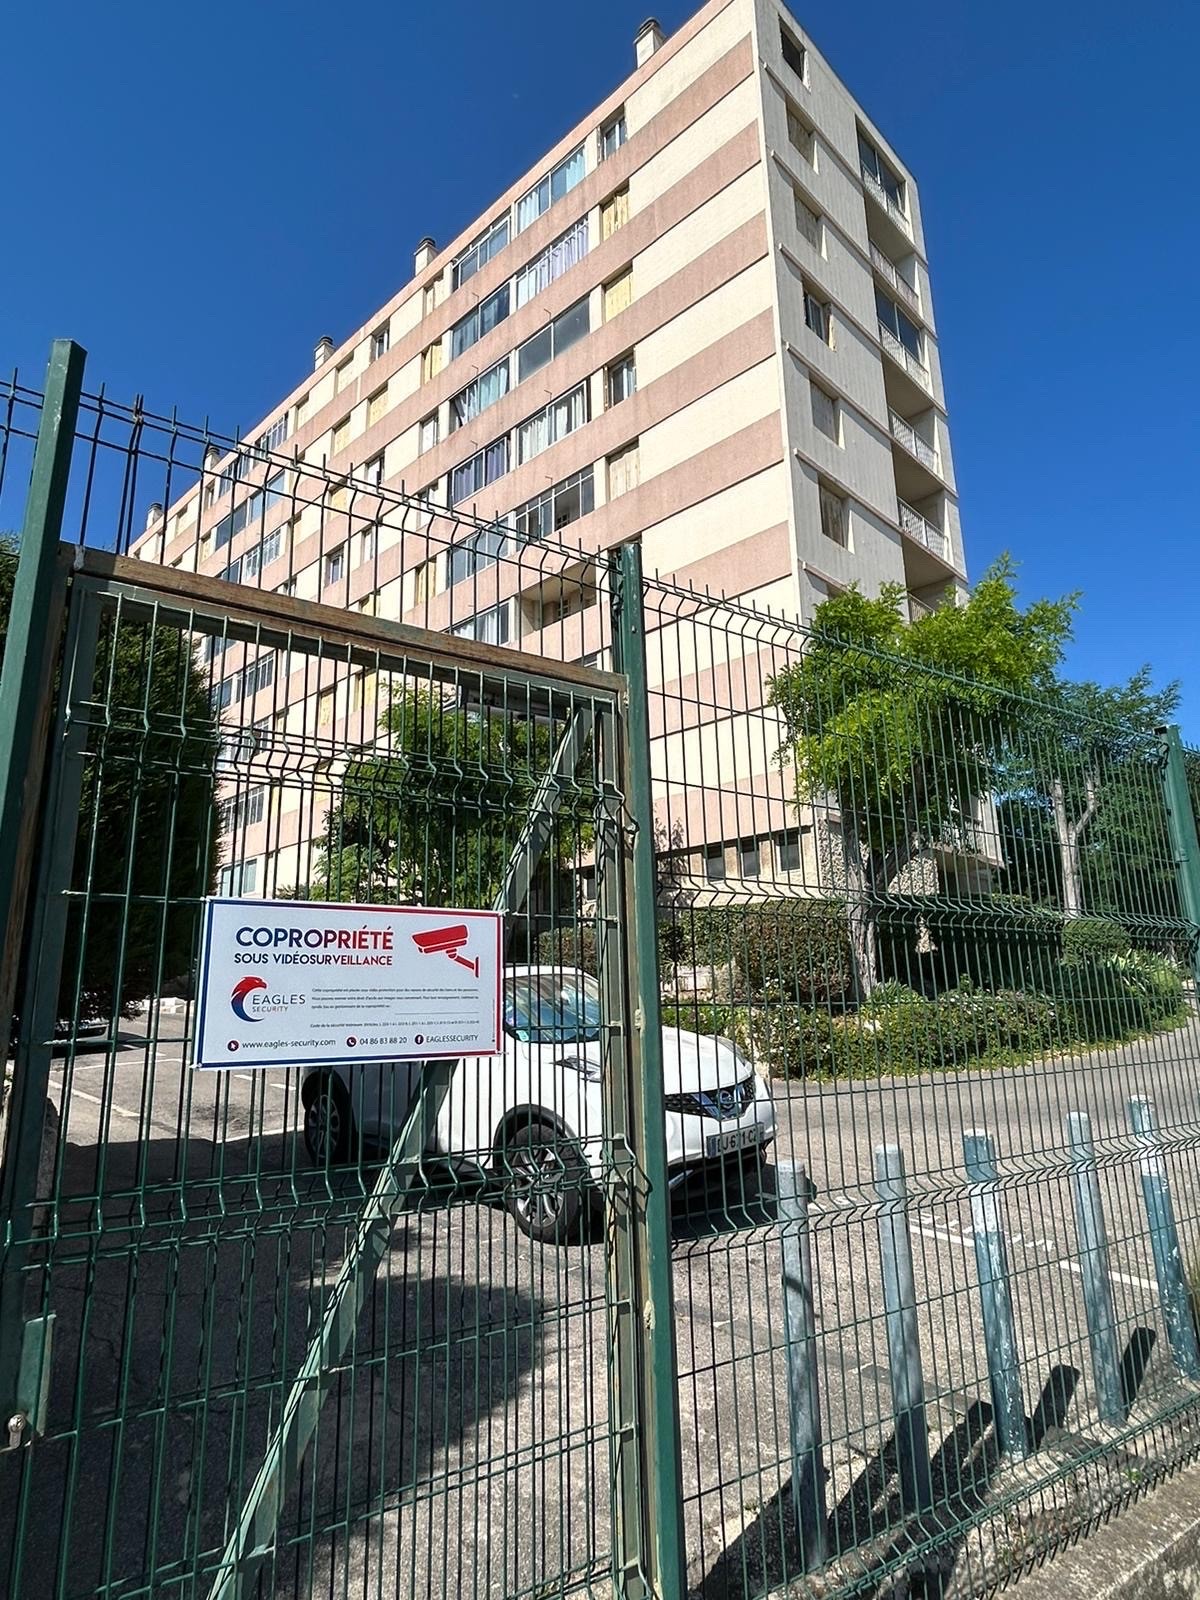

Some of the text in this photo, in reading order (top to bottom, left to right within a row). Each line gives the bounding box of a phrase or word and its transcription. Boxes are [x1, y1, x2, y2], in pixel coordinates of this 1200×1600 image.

[236, 925, 394, 950] COPROPRIÉTÉ
[234, 951, 393, 965] SOUS VIDÉOSURVEILLANCE
[252, 994, 306, 1005] EAGLES
[252, 1005, 289, 1013] SECURITY
[380, 1037, 388, 1045] 83
[399, 1036, 408, 1044] 20
[426, 1034, 479, 1043] EAGLESSECURITY
[242, 1039, 336, 1049] www.eagles-security.com
